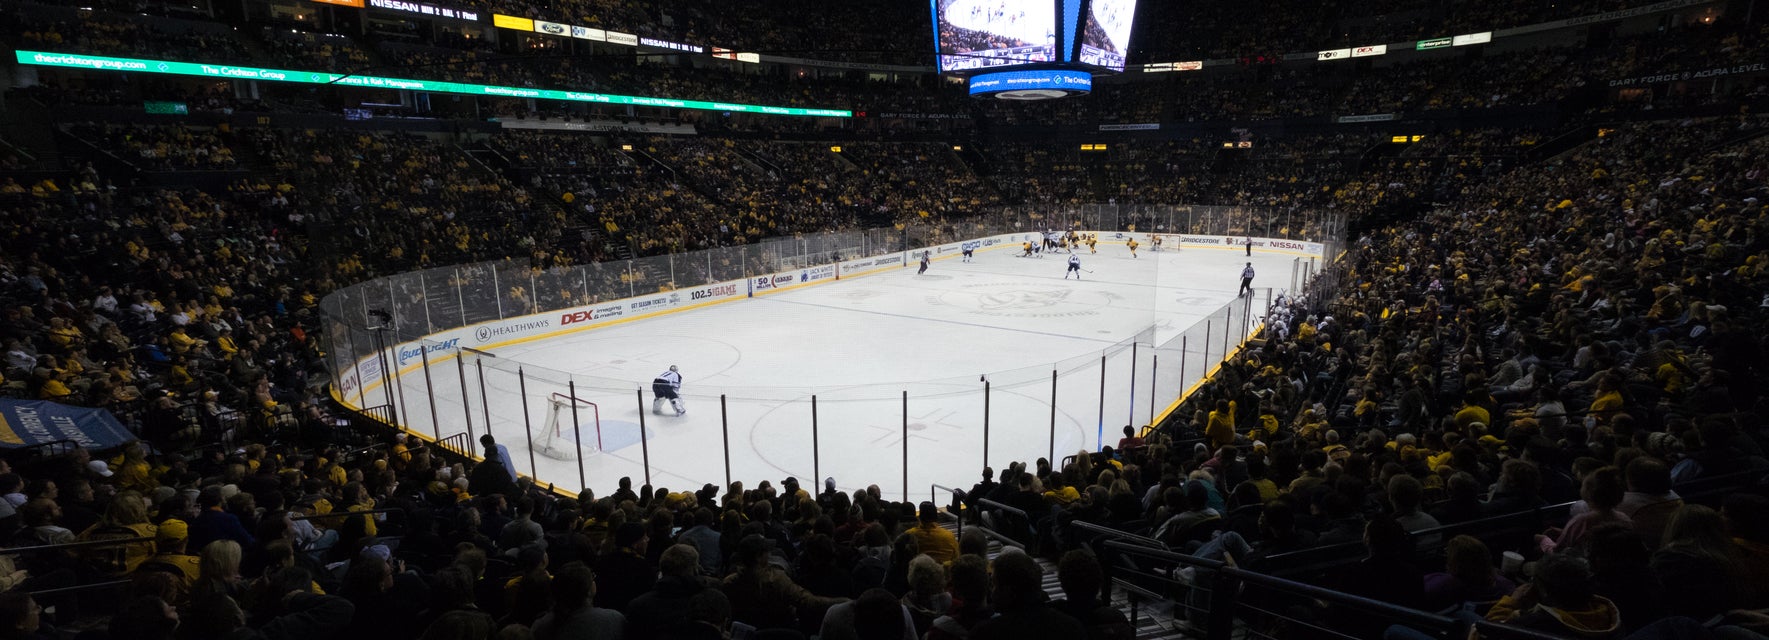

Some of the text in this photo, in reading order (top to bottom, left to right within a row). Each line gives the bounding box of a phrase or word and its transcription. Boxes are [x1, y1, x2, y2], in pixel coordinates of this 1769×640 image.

[370, 0, 419, 13] NISSAN
[435, 7, 440, 16] 2
[462, 11, 477, 21] Final
[545, 24, 562, 33] Ford
[640, 37, 669, 48] NISSAN
[34, 53, 147, 70] thecrichtongroup.com
[200, 65, 286, 81] The Crichton Group
[1609, 63, 1766, 87] GARY FORCE ACURA LEVEL
[1180, 236, 1219, 245] BRIDGESTONE
[1235, 238, 1264, 247] Locnvar
[1269, 241, 1304, 250] NISSAN
[758, 277, 768, 286] 50
[691, 288, 712, 300] 102.5
[715, 284, 736, 297] GAME
[596, 305, 622, 313] imaging
[638, 299, 651, 308] SEASON
[561, 310, 593, 325] DEX
[600, 311, 622, 319] mailing
[492, 319, 550, 337] HEALTHWAYS
